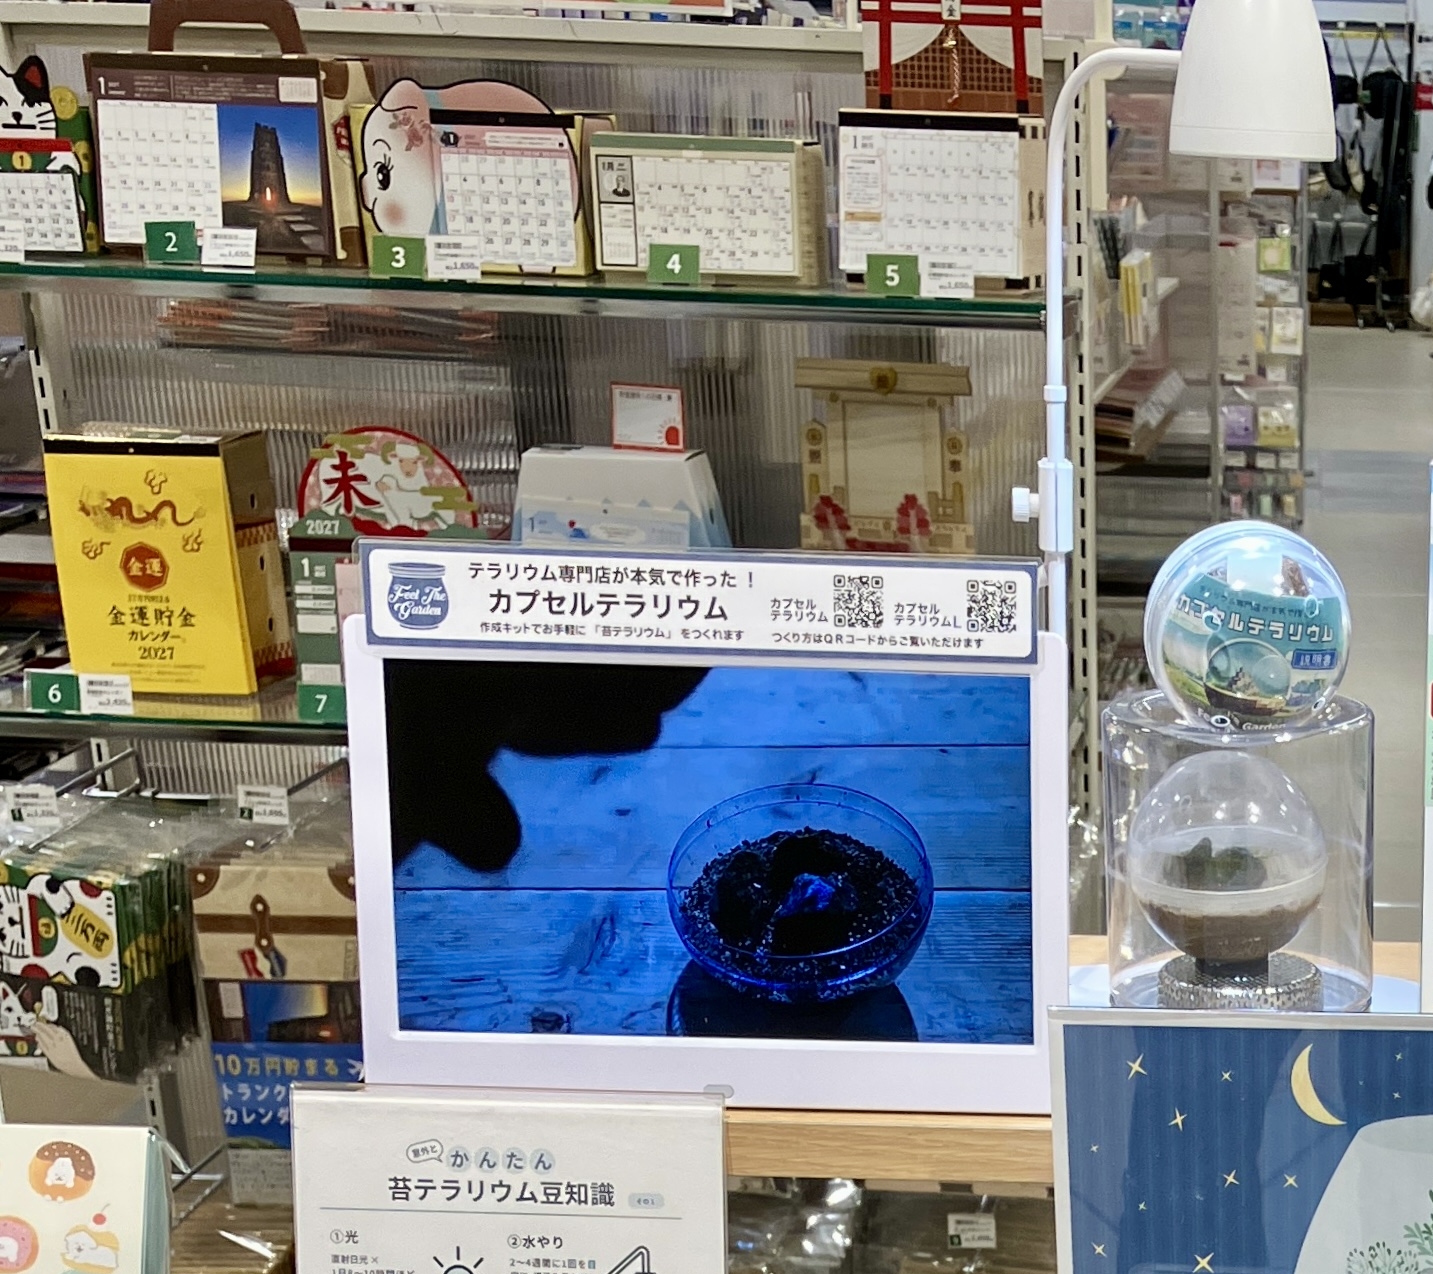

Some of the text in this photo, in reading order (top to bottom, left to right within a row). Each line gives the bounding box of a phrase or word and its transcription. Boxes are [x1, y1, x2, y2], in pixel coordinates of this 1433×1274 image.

[165, 232, 178, 251] 2
[391, 246, 405, 268] 3
[666, 253, 681, 274] 4
[886, 266, 899, 286] 5
[322, 450, 381, 516] 未
[306, 519, 340, 536] 2027
[301, 558, 309, 577] 1
[394, 600, 443, 619] Garden
[490, 587, 729, 623] カプセルテラリウム
[770, 598, 817, 609] カプセル
[894, 602, 940, 615] カプセル
[107, 605, 197, 628] 金運貯金
[770, 609, 828, 623] テラリウム
[894, 614, 962, 629] テラリウムL
[138, 646, 175, 660] 2027
[48, 684, 62, 703] 6
[315, 694, 328, 713] 7
[450, 1150, 553, 1170] かんたん
[388, 1177, 615, 1207] 苔テラリウム豆知識
